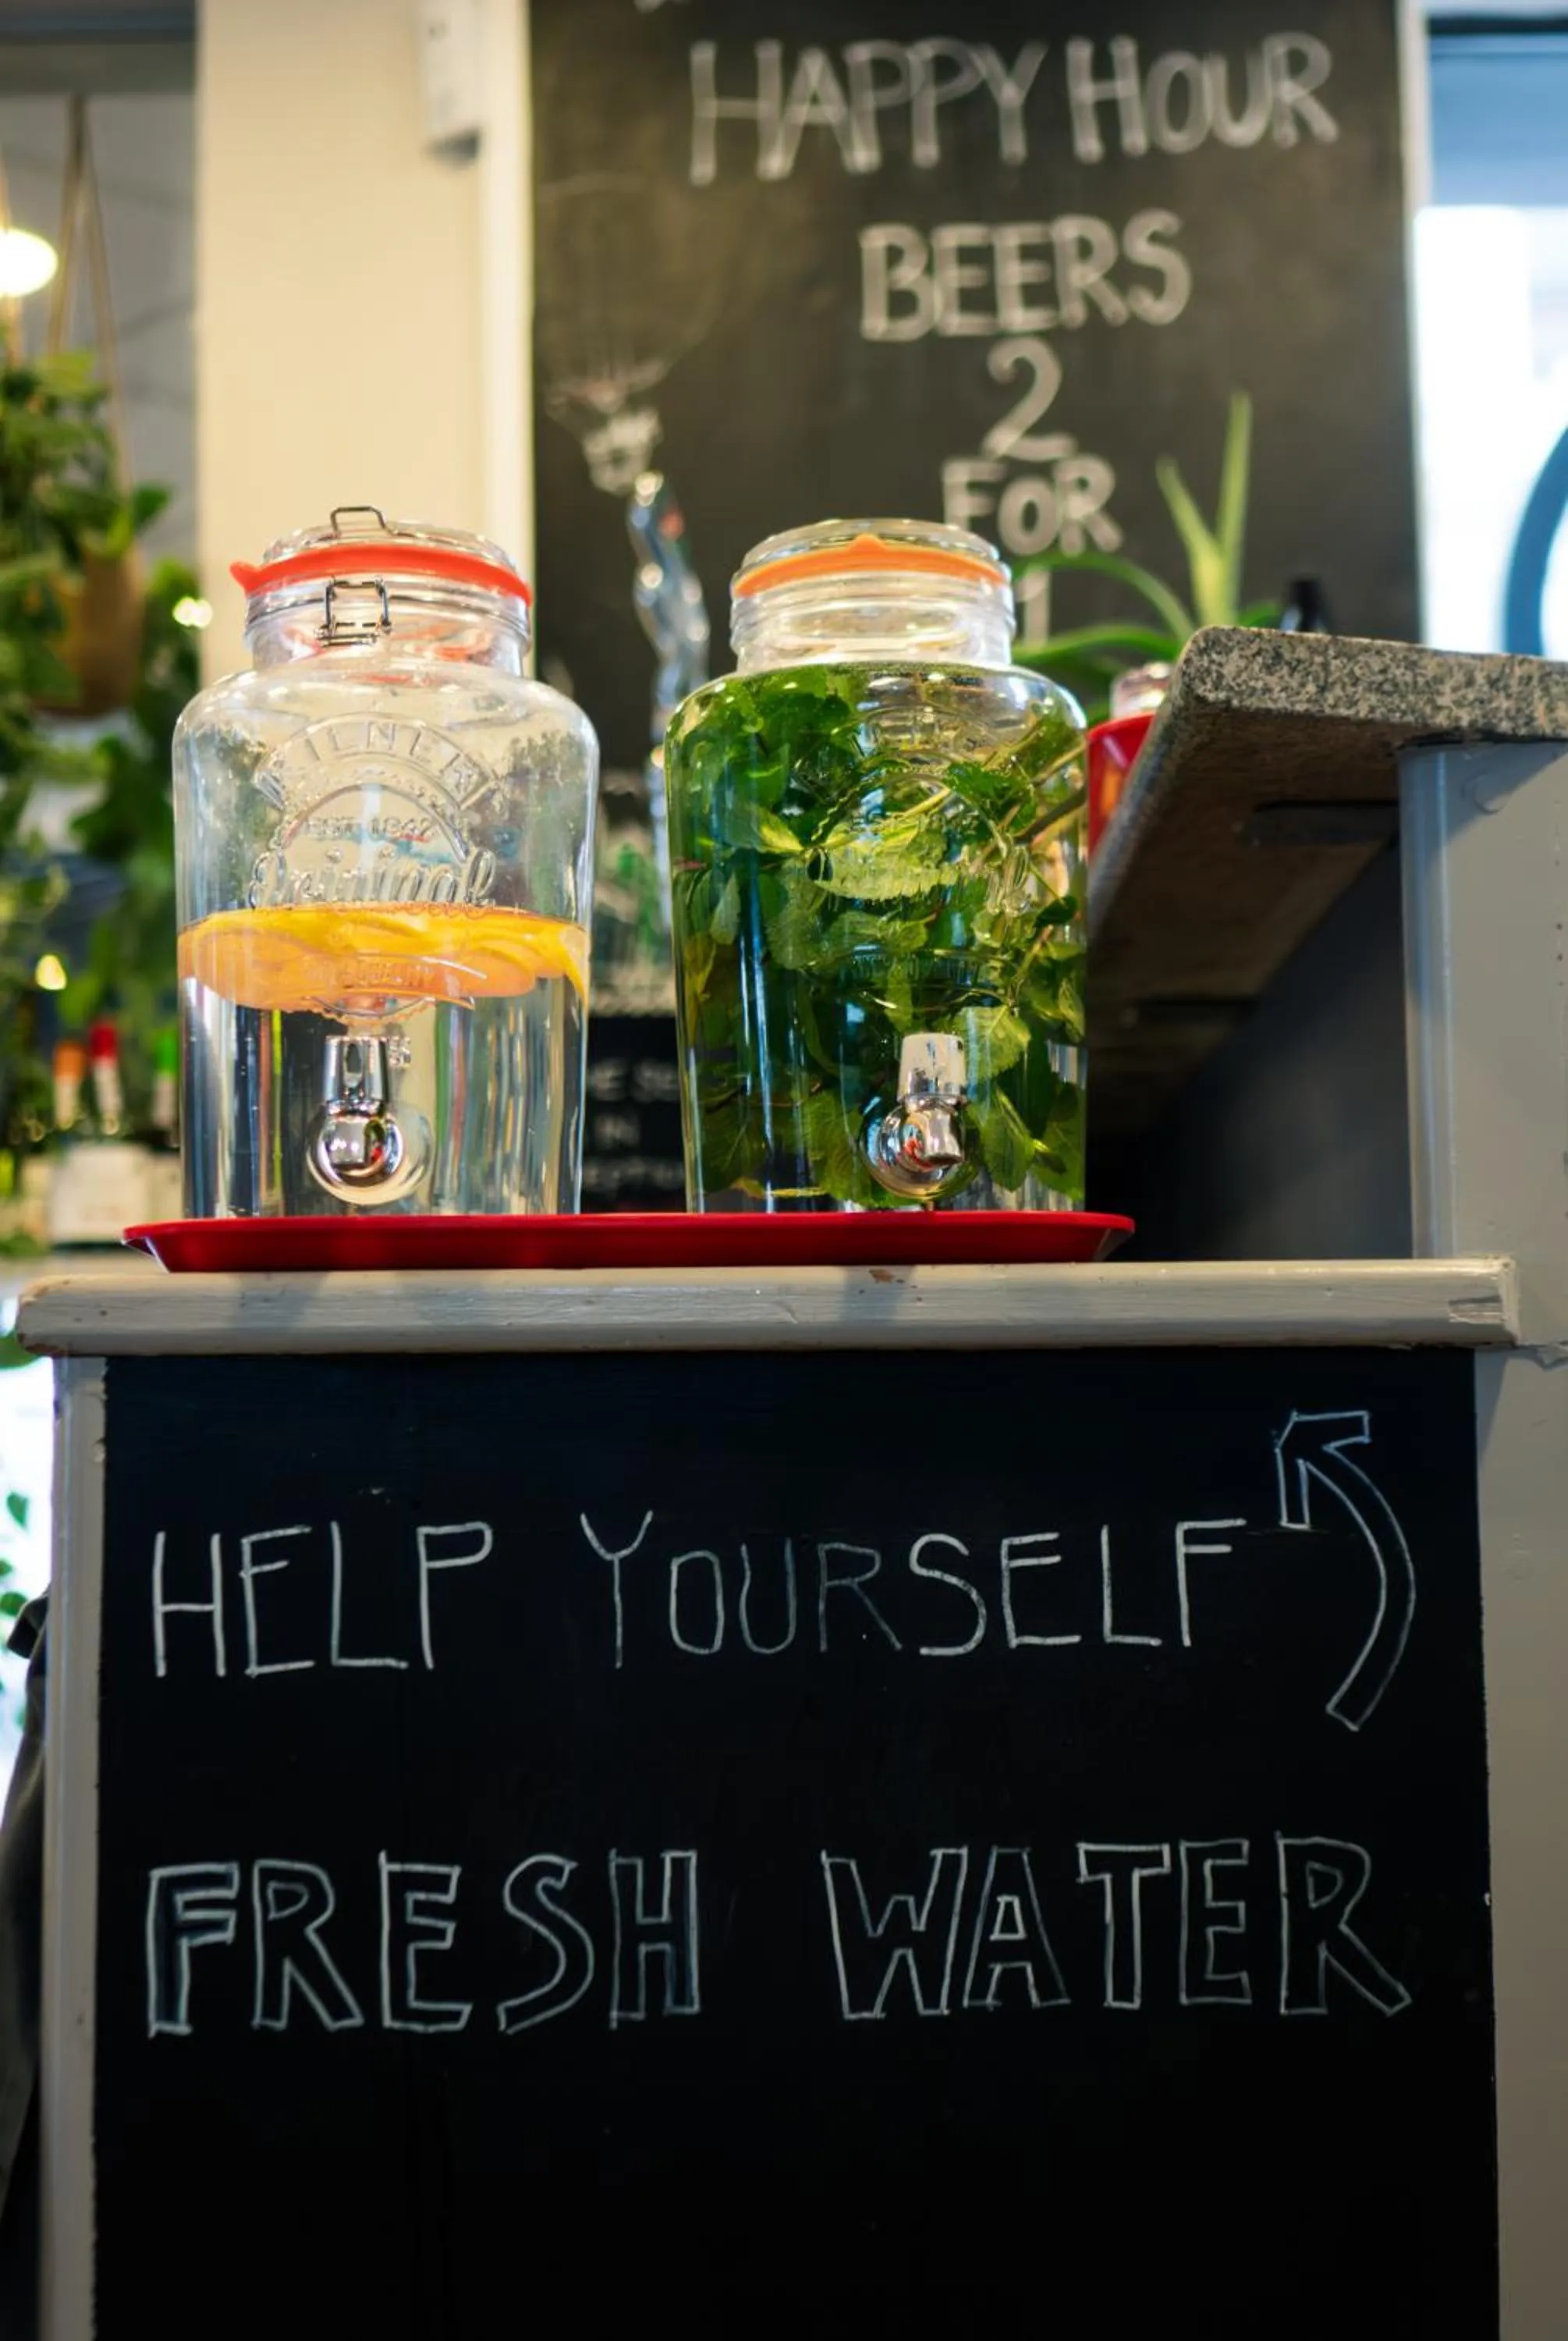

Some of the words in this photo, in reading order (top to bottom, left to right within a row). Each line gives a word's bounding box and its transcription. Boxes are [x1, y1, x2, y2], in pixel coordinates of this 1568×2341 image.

[689, 39, 1048, 186] HAPPY
[1066, 33, 1339, 163] HOUR
[859, 208, 1193, 342] BEERS
[982, 336, 1077, 462] 2
[942, 456, 1123, 556] FOR
[153, 1522, 493, 1678] HELP
[580, 1510, 1247, 1670] YOURSELF
[146, 1849, 701, 2038] FRESH
[820, 1831, 1413, 2020] WATER
